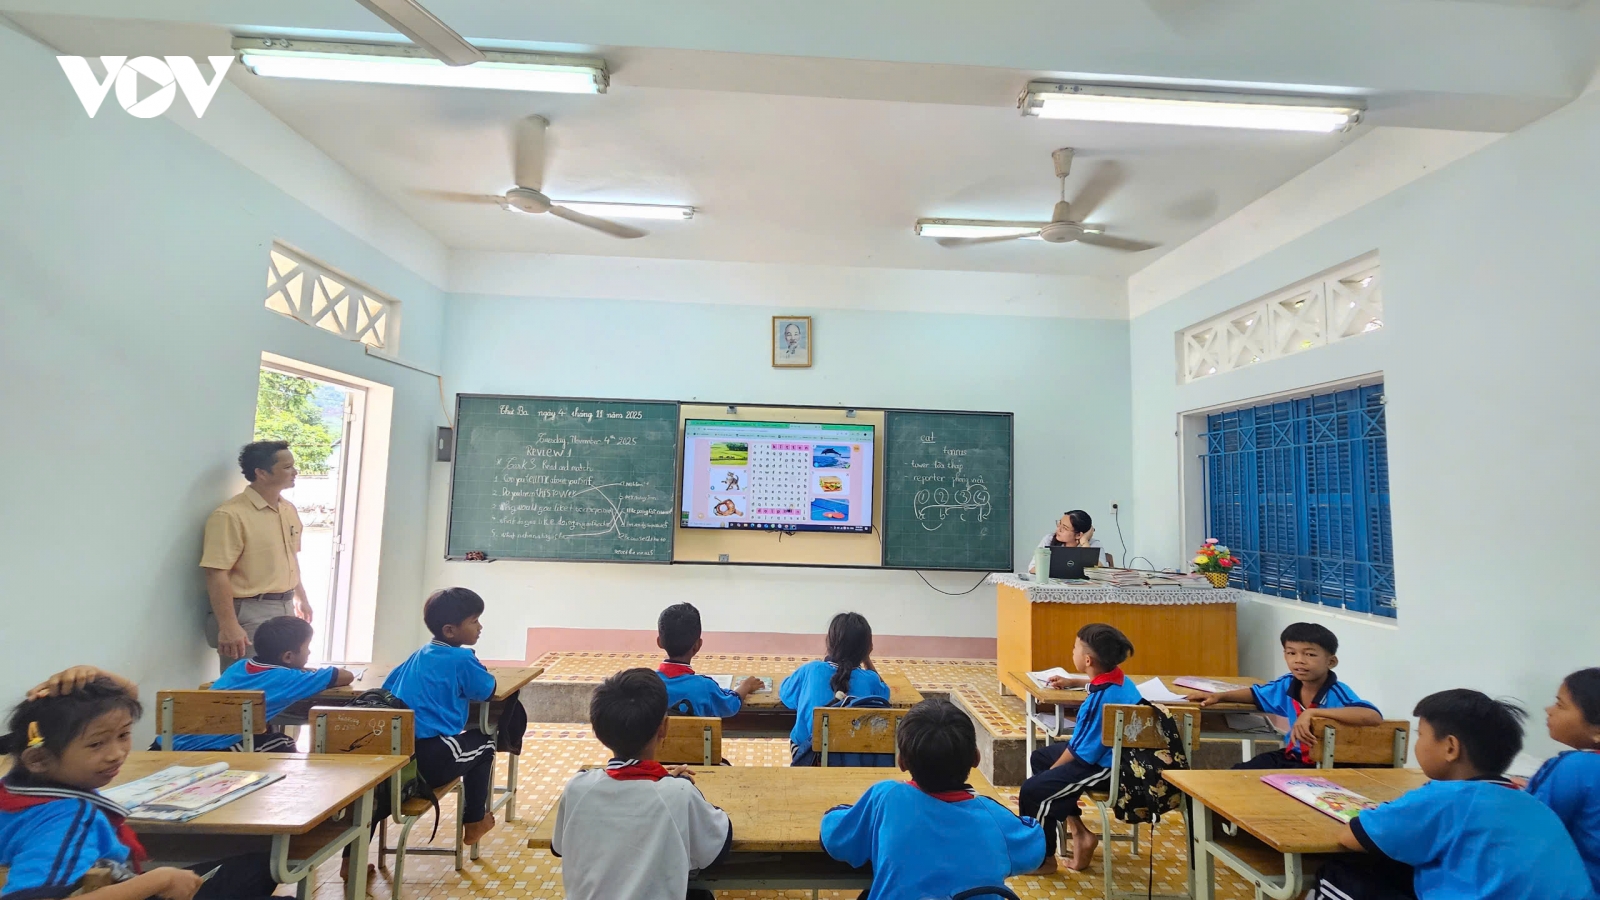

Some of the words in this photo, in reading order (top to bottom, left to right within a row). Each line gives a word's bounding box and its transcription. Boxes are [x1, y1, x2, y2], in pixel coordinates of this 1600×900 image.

[517, 405, 529, 415] Ba
[538, 409, 556, 421] ngày
[571, 407, 593, 423] tháng
[596, 410, 603, 418] 11
[625, 411, 643, 420] 2025
[617, 436, 637, 446] 2025
[542, 459, 557, 471] Read
[911, 459, 930, 469] tower
[913, 473, 946, 485] reporter
